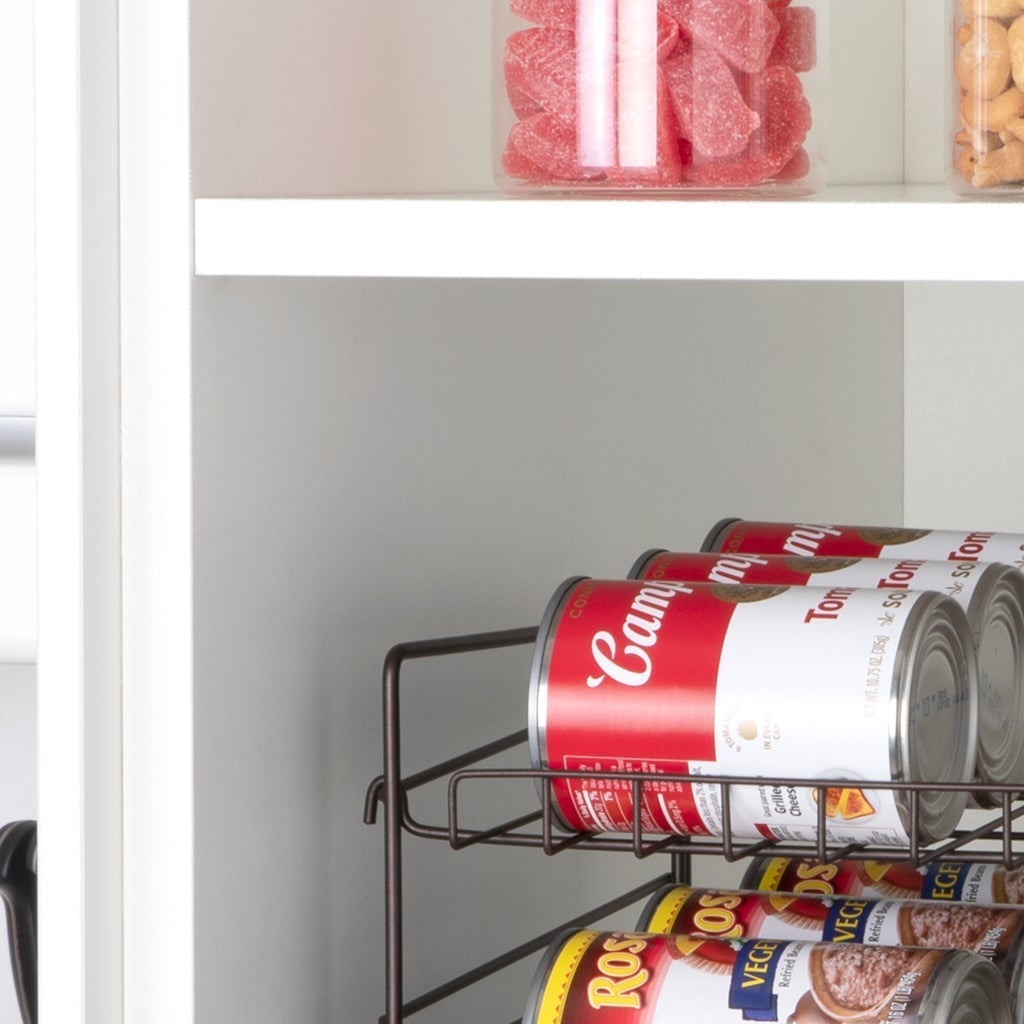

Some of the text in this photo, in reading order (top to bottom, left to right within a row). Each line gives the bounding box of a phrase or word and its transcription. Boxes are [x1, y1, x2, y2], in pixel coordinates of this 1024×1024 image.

[871, 656, 883, 667] OZ
[763, 741, 771, 750] IN
[771, 786, 786, 814] Grille
[787, 786, 802, 817] Chees
[742, 940, 784, 989] VEGE
[779, 959, 795, 988] Refried
